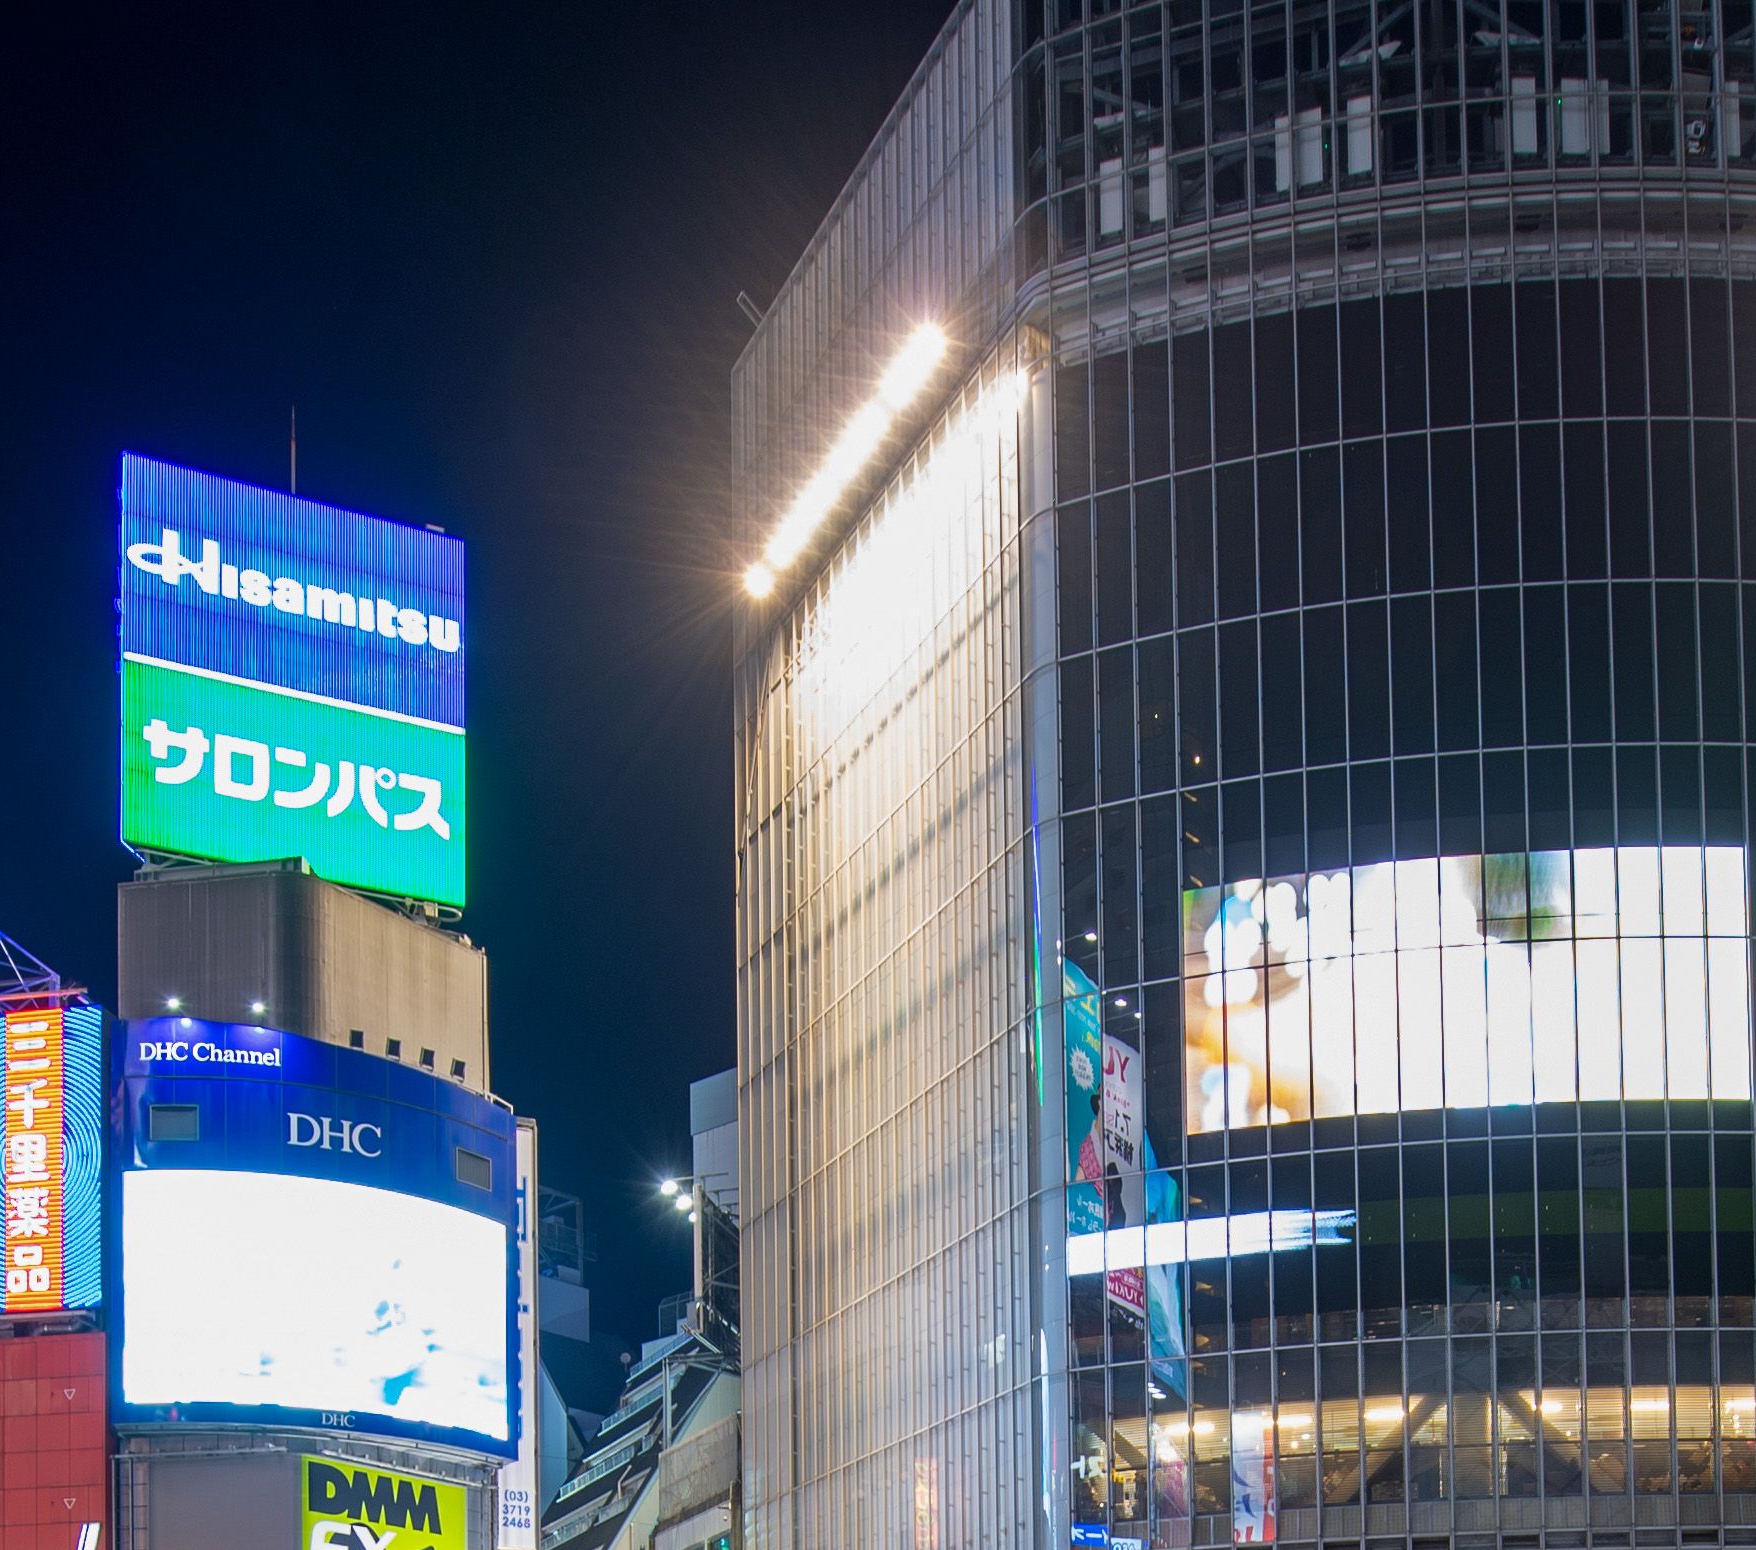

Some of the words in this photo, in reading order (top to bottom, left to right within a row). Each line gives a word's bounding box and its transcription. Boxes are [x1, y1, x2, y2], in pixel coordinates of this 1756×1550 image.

[126, 528, 460, 653] Hisamitsu
[143, 718, 450, 841] サロンパス
[139, 1042, 189, 1062] DHC
[192, 1042, 282, 1067] Channel
[286, 1112, 382, 1158] DHC
[6, 1019, 51, 1294] 三千里薬品
[321, 1411, 356, 1429] DHC
[307, 1461, 442, 1535] DMM
[502, 1504, 531, 1516] 3719
[503, 1490, 529, 1504] (03)
[502, 1516, 531, 1529] 2468
